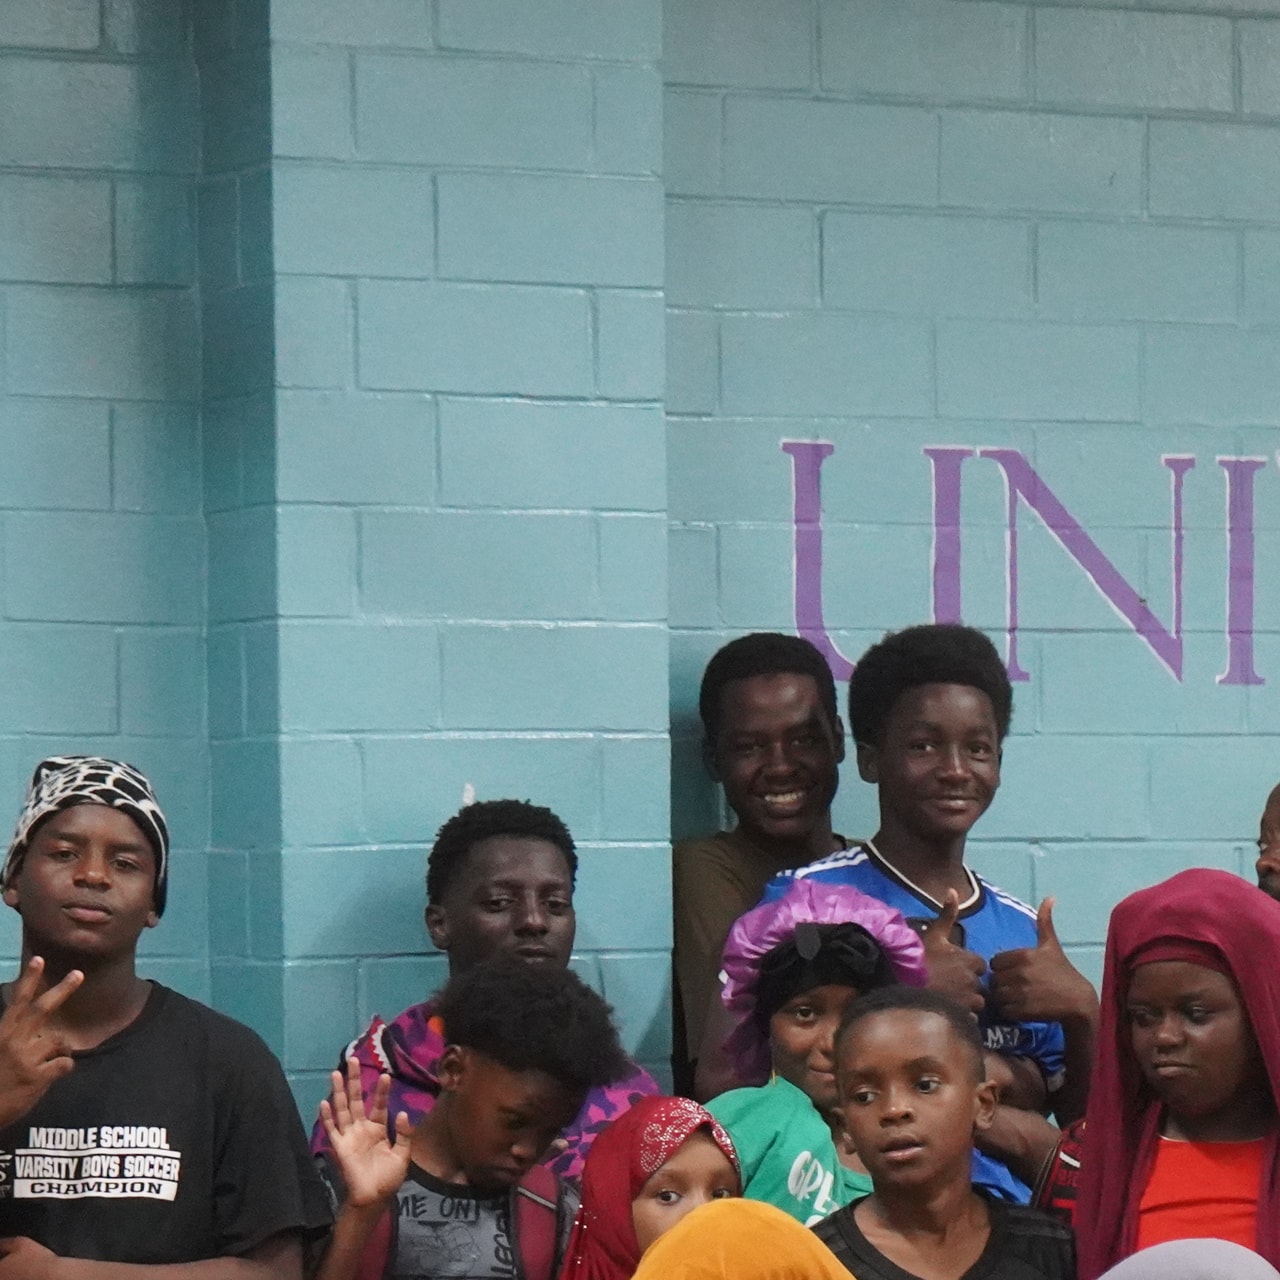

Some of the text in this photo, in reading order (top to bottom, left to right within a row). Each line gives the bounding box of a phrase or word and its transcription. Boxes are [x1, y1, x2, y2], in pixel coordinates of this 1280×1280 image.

[28, 1126, 170, 1150] MIDDLE SCHOOL
[15, 1155, 79, 1179] VARSITY
[81, 1155, 120, 1179] BOYS
[123, 1156, 180, 1181] SOCCER
[31, 1181, 162, 1195] CHAMPION
[787, 1150, 840, 1215] GRE
